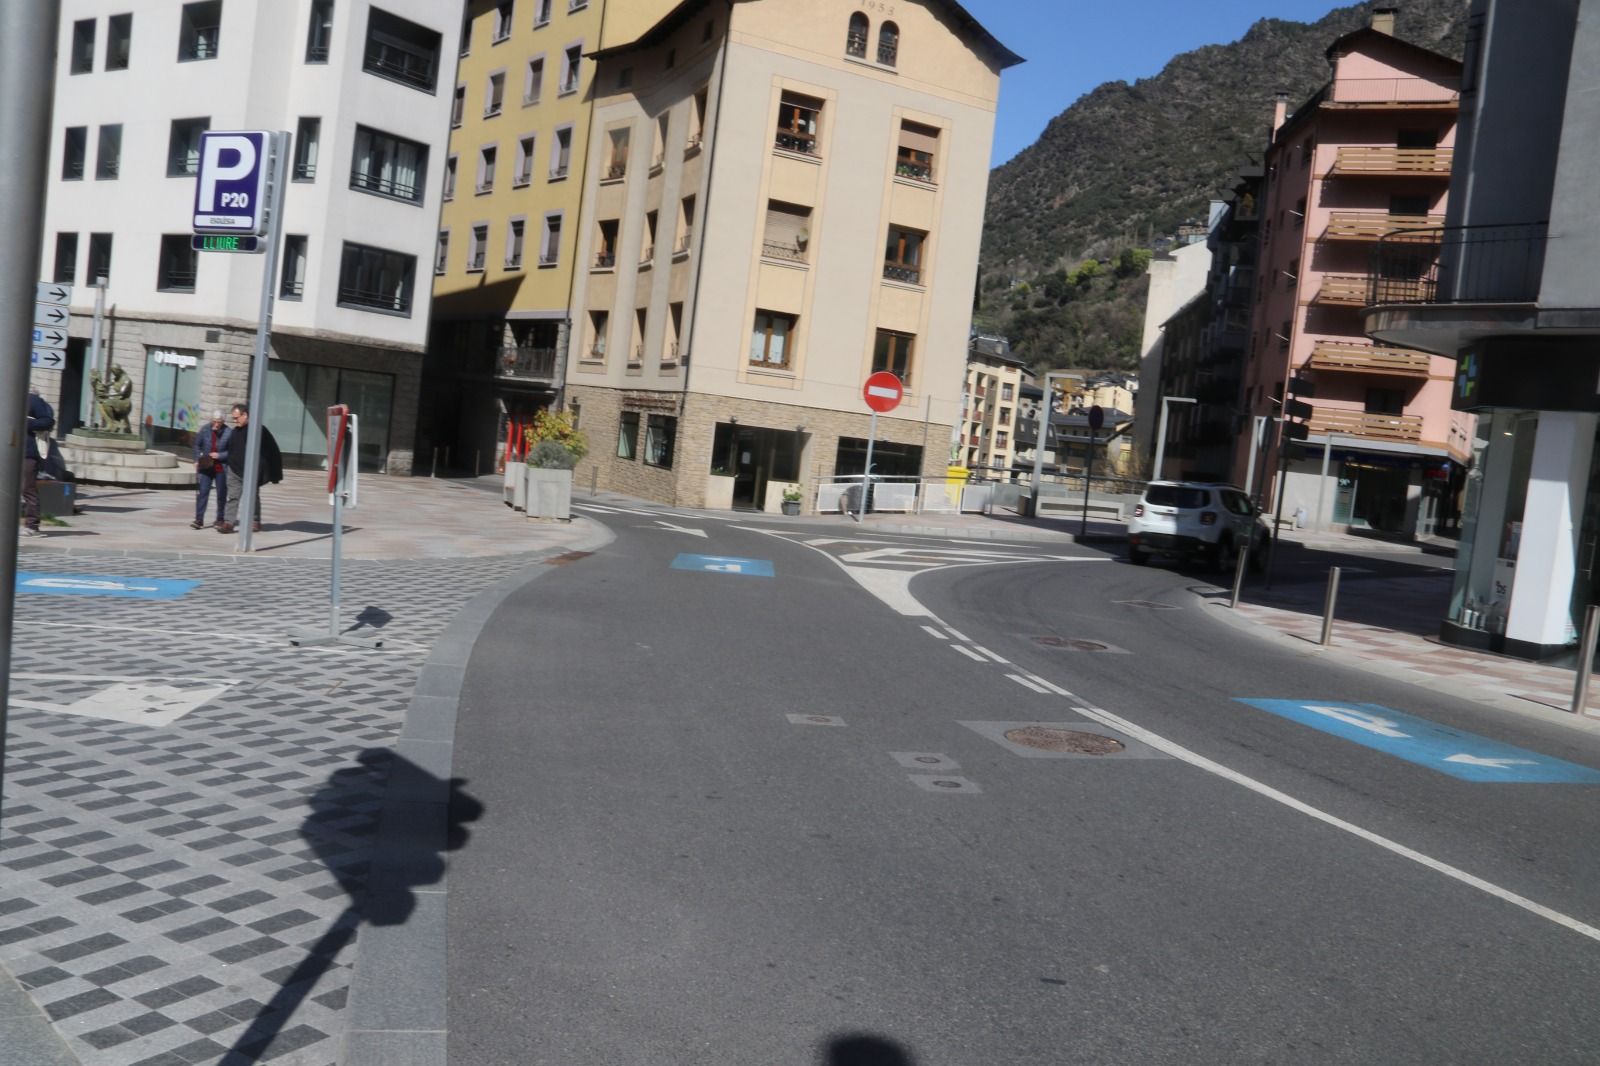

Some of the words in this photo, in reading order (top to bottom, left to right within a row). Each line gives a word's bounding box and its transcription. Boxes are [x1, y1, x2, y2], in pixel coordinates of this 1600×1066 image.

[198, 136, 256, 212] P
[221, 192, 249, 208] P20
[203, 236, 240, 250] LLIURE
